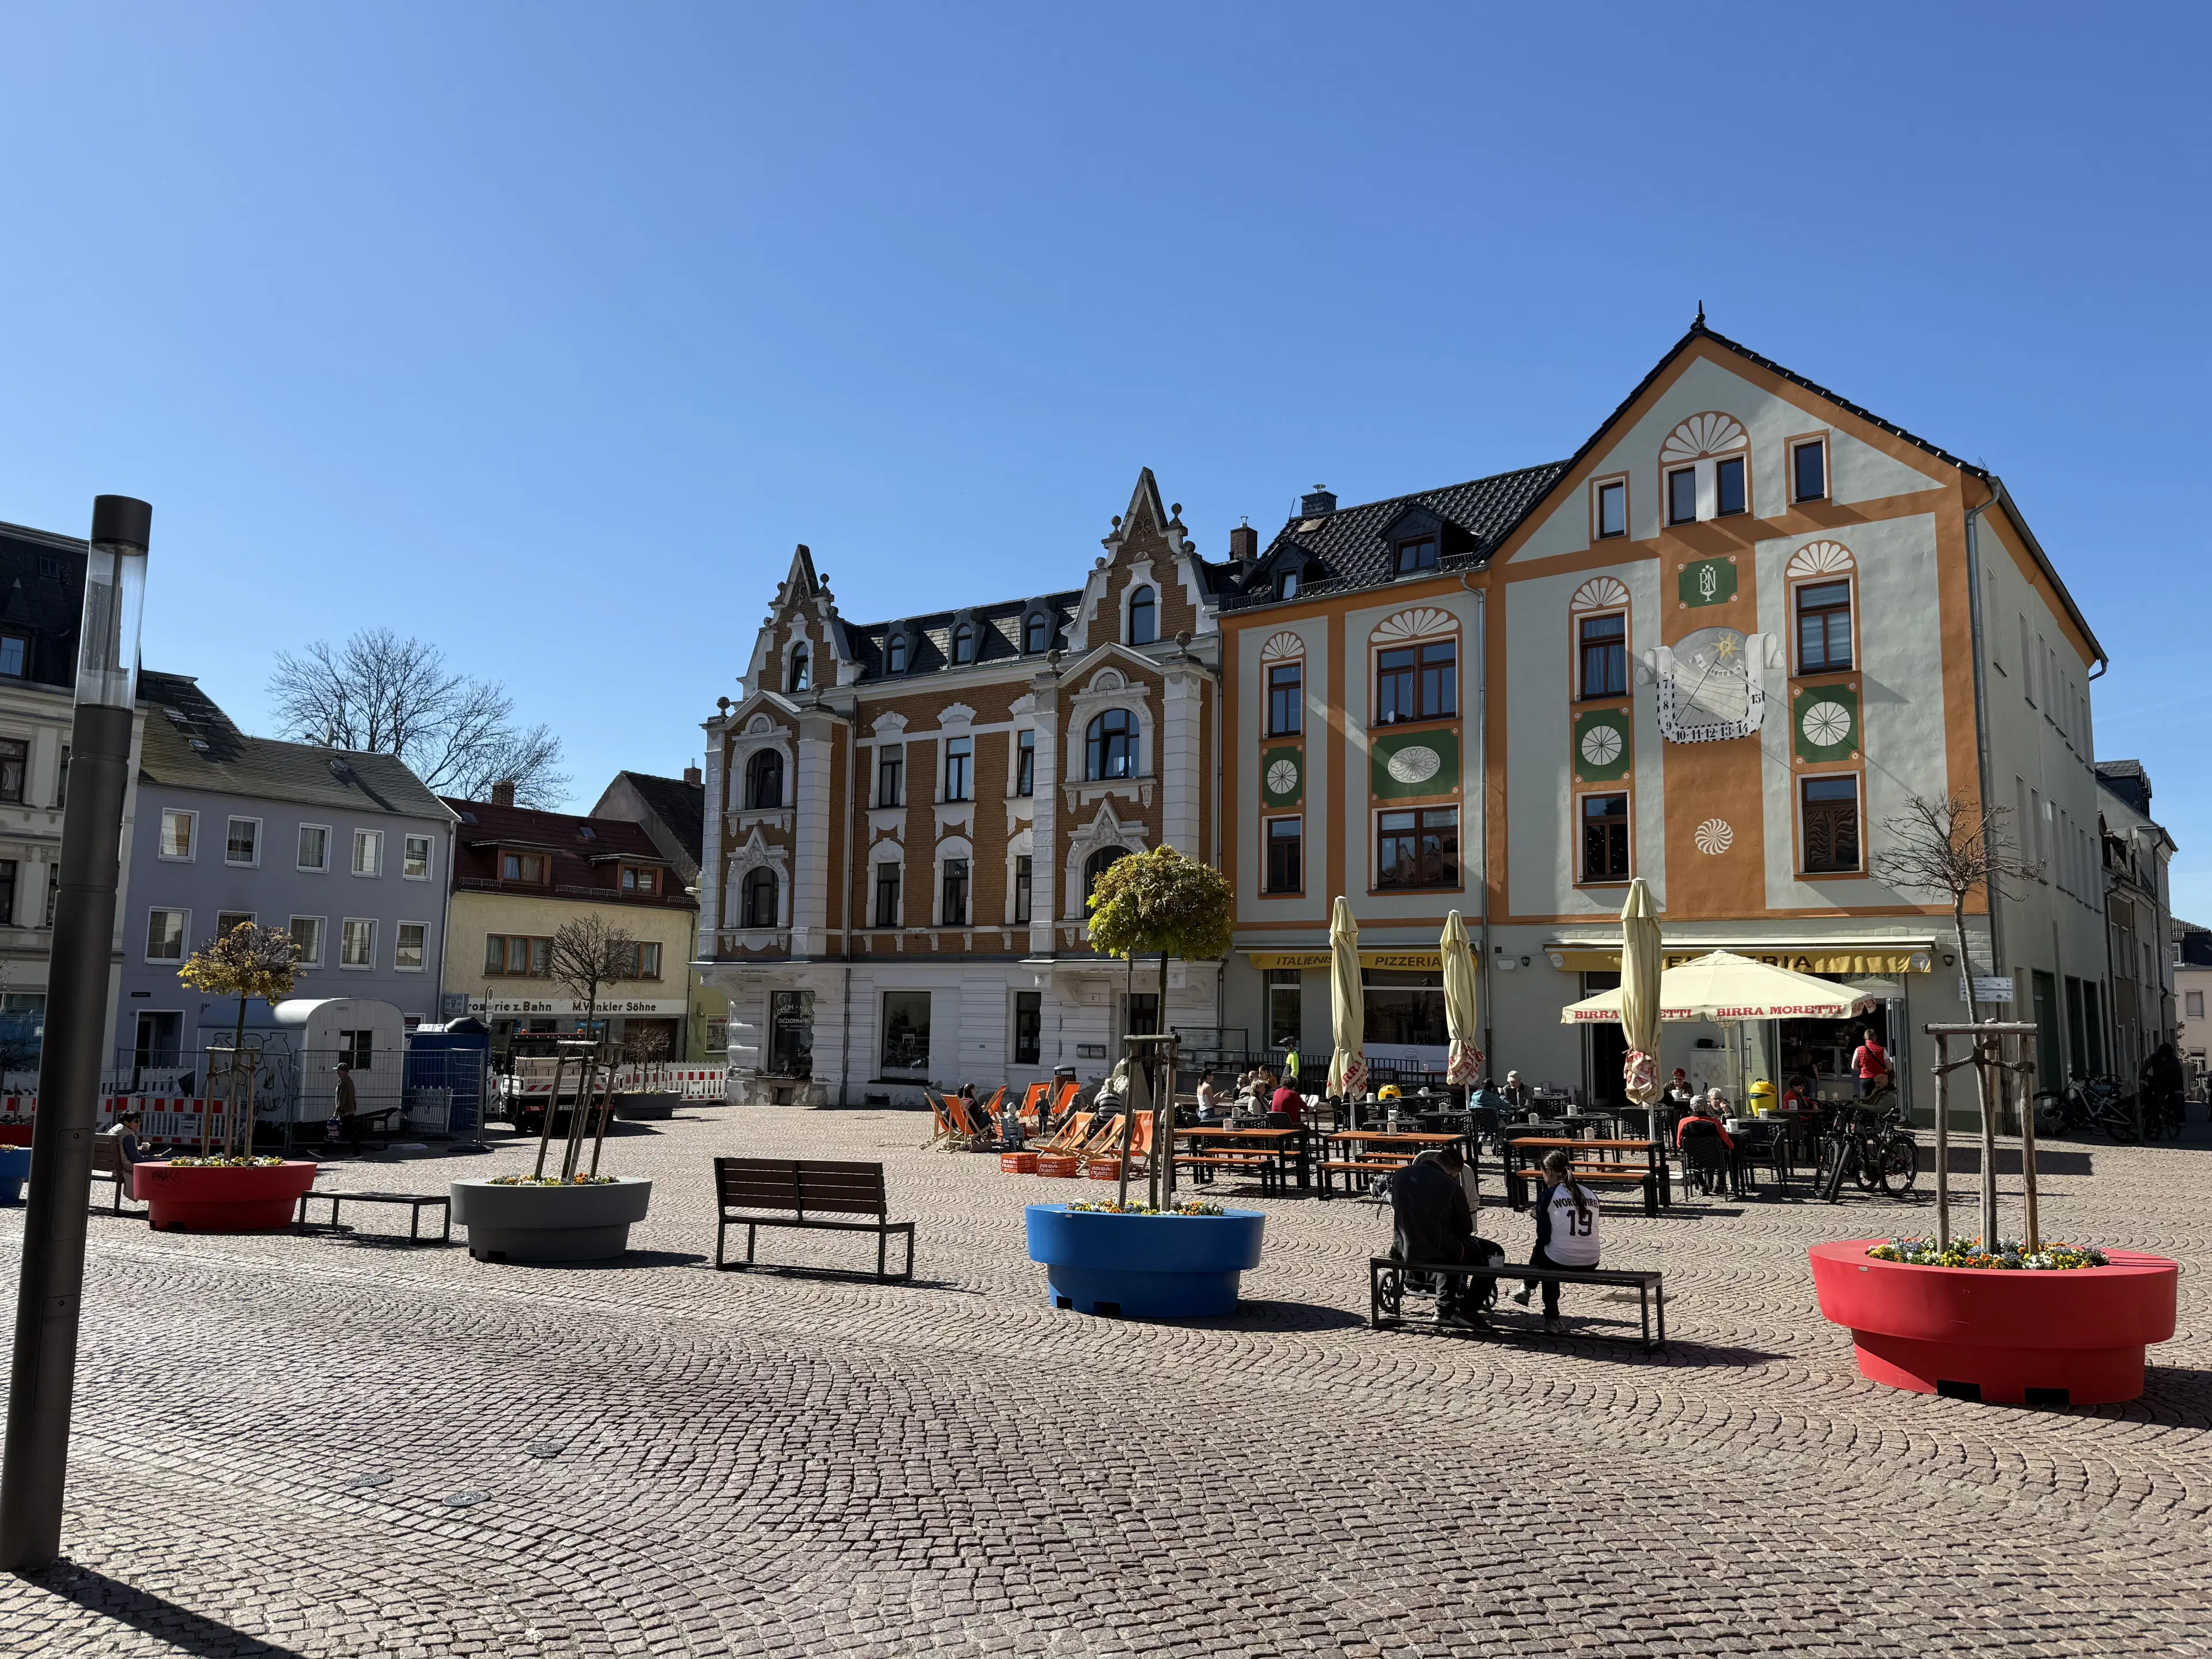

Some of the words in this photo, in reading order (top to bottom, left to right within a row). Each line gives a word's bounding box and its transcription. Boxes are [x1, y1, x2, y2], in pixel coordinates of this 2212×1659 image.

[1699, 570, 1717, 592] BN
[1662, 679, 1668, 689] 7
[1750, 694, 1761, 704] 15
[1663, 700, 1669, 710] 8
[1666, 721, 1672, 731] 9
[1675, 730, 1685, 740] 10
[1690, 729, 1700, 740] 11
[1705, 728, 1715, 738] 12
[1719, 726, 1732, 737] 13
[1737, 723, 1748, 734] 14
[1277, 956, 1363, 965] ITALIENISE
[1374, 957, 1442, 967] PIZZERIA
[523, 1001, 551, 1012] Bahn
[627, 1001, 656, 1012] Söhne
[1716, 1007, 1763, 1017] BIRRA
[1769, 1005, 1842, 1015] MORETTI
[1574, 1010, 1619, 1019] BIRRA
[1661, 1009, 1692, 1018] ETTI
[1566, 1210, 1593, 1236] 19
